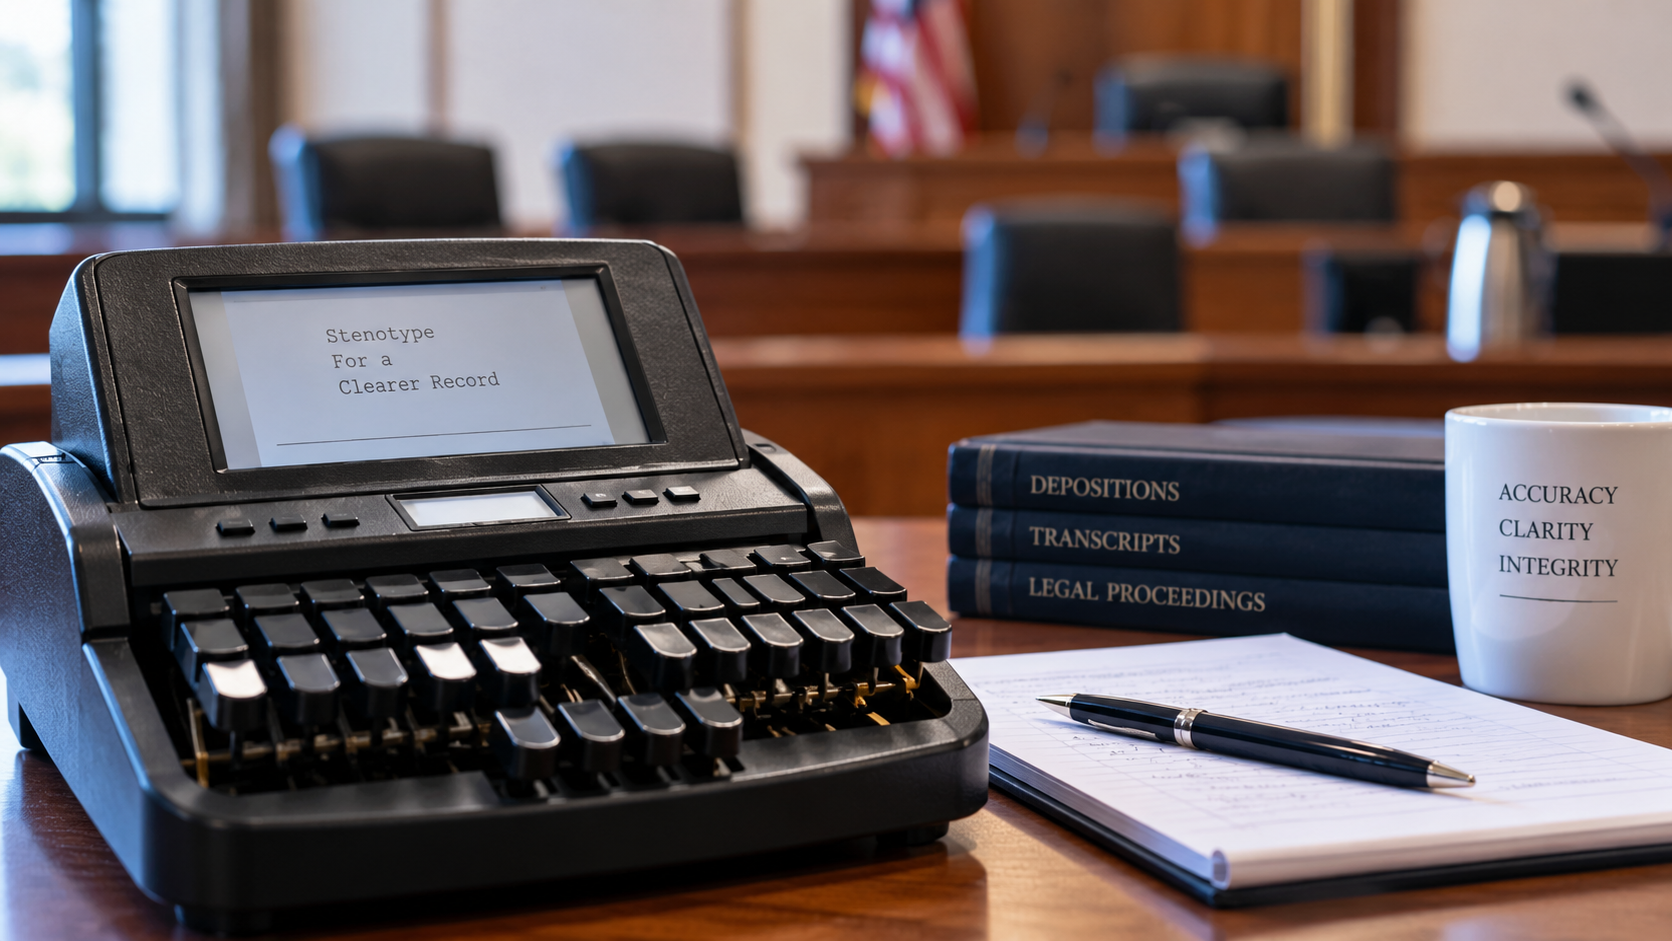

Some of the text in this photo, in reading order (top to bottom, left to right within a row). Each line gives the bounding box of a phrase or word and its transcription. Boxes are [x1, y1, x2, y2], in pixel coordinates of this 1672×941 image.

[325, 326, 435, 344] Stenotype
[332, 354, 393, 369] For a
[338, 371, 501, 395] Clearer Record
[1030, 475, 1179, 501] DEPOSITIONS
[1499, 483, 1618, 504] ACCURACY
[1029, 526, 1180, 554] TRANSCRIPTS
[1499, 518, 1593, 541] CLARITY
[1499, 554, 1618, 577] INTEGRITY
[1028, 577, 1265, 612] LEGAL PROCEEDINGS
